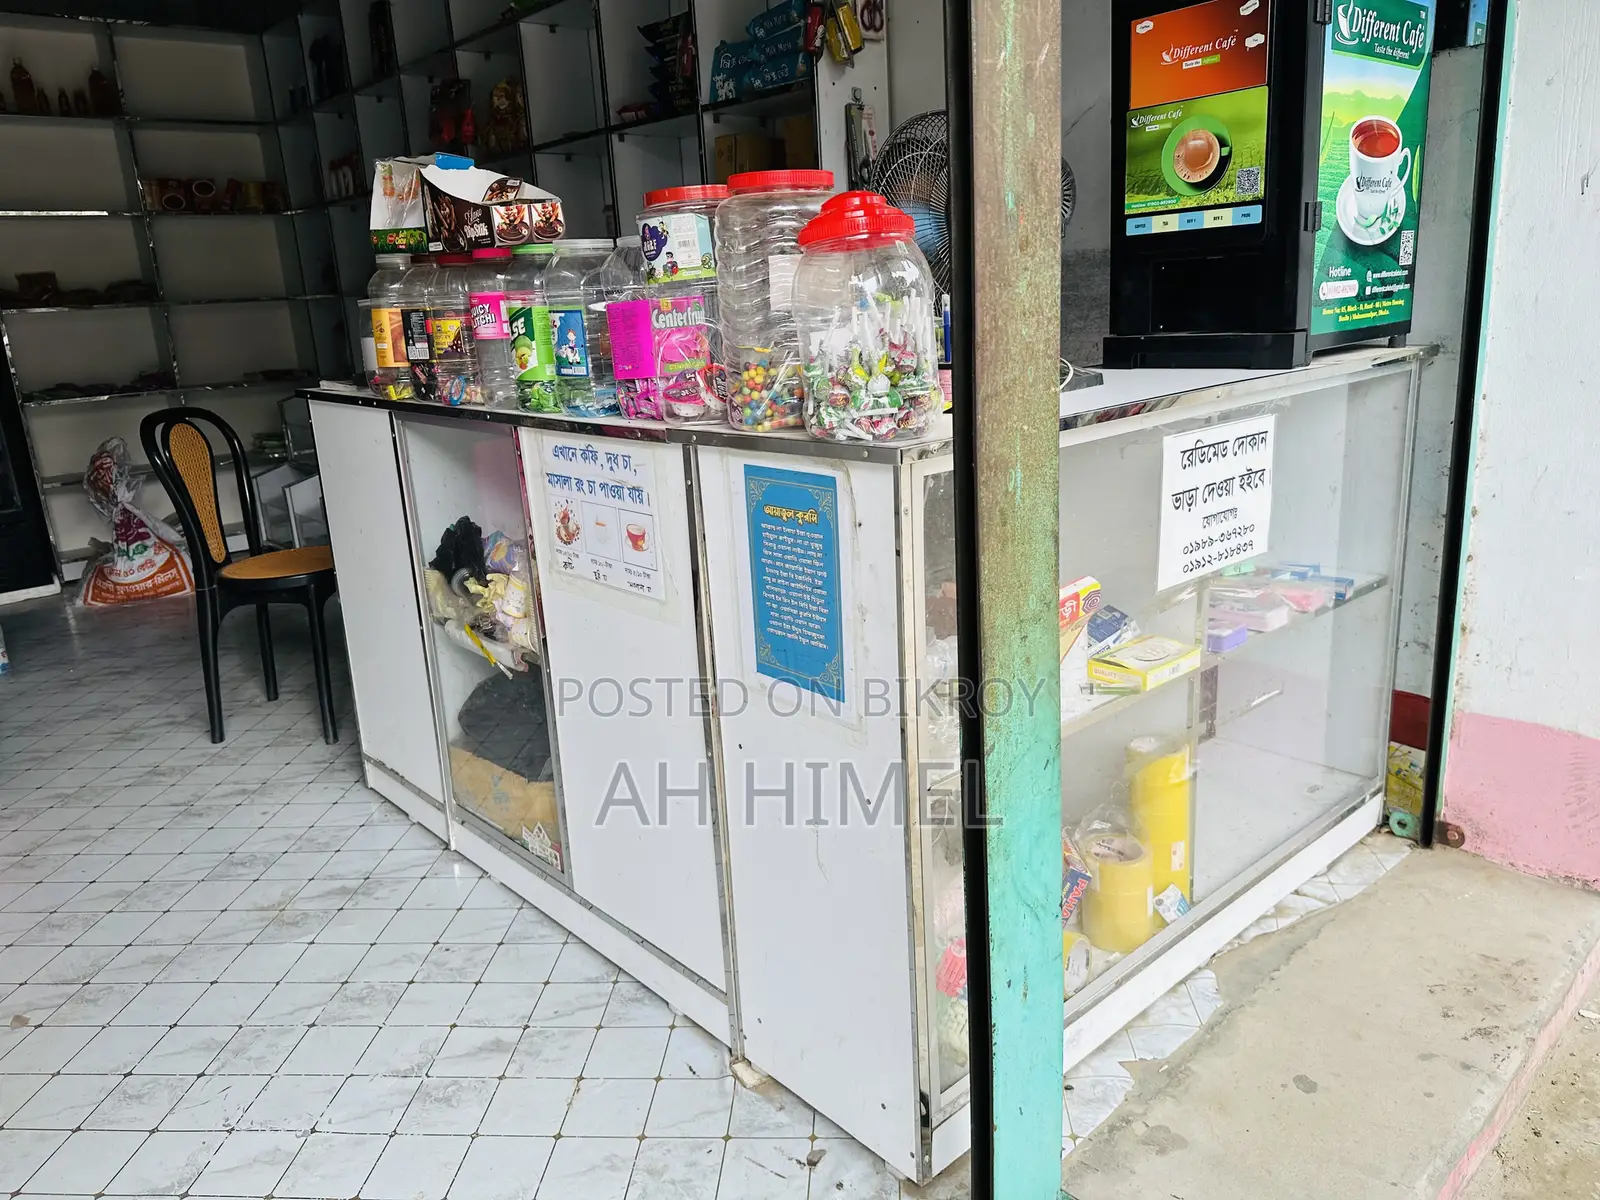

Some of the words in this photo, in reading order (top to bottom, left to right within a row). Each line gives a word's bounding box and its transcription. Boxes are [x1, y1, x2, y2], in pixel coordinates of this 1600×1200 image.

[1351, 6, 1400, 44] Different
[1173, 41, 1212, 60] Different
[1374, 43, 1385, 54] Taste
[1139, 113, 1167, 124] Different
[1329, 266, 1351, 277] Hotline
[552, 444, 578, 463] এখানে
[605, 451, 619, 473] দুধ
[1180, 439, 1229, 470] রেডিমেড
[1232, 430, 1268, 457] দোকান
[574, 478, 586, 495] রং
[587, 480, 596, 496] চা
[598, 481, 624, 502] পাওয়া
[1172, 487, 1199, 512] ভাড়া
[1202, 476, 1235, 504] দেওয়া
[1239, 465, 1266, 492] হইবে
[1182, 524, 1255, 555] ০১৯৮৯-৩৬৭২৮০
[1182, 540, 1254, 574] ০১৯১২-৮১৮৪৩৭
[1062, 878, 1088, 928] PAHA
